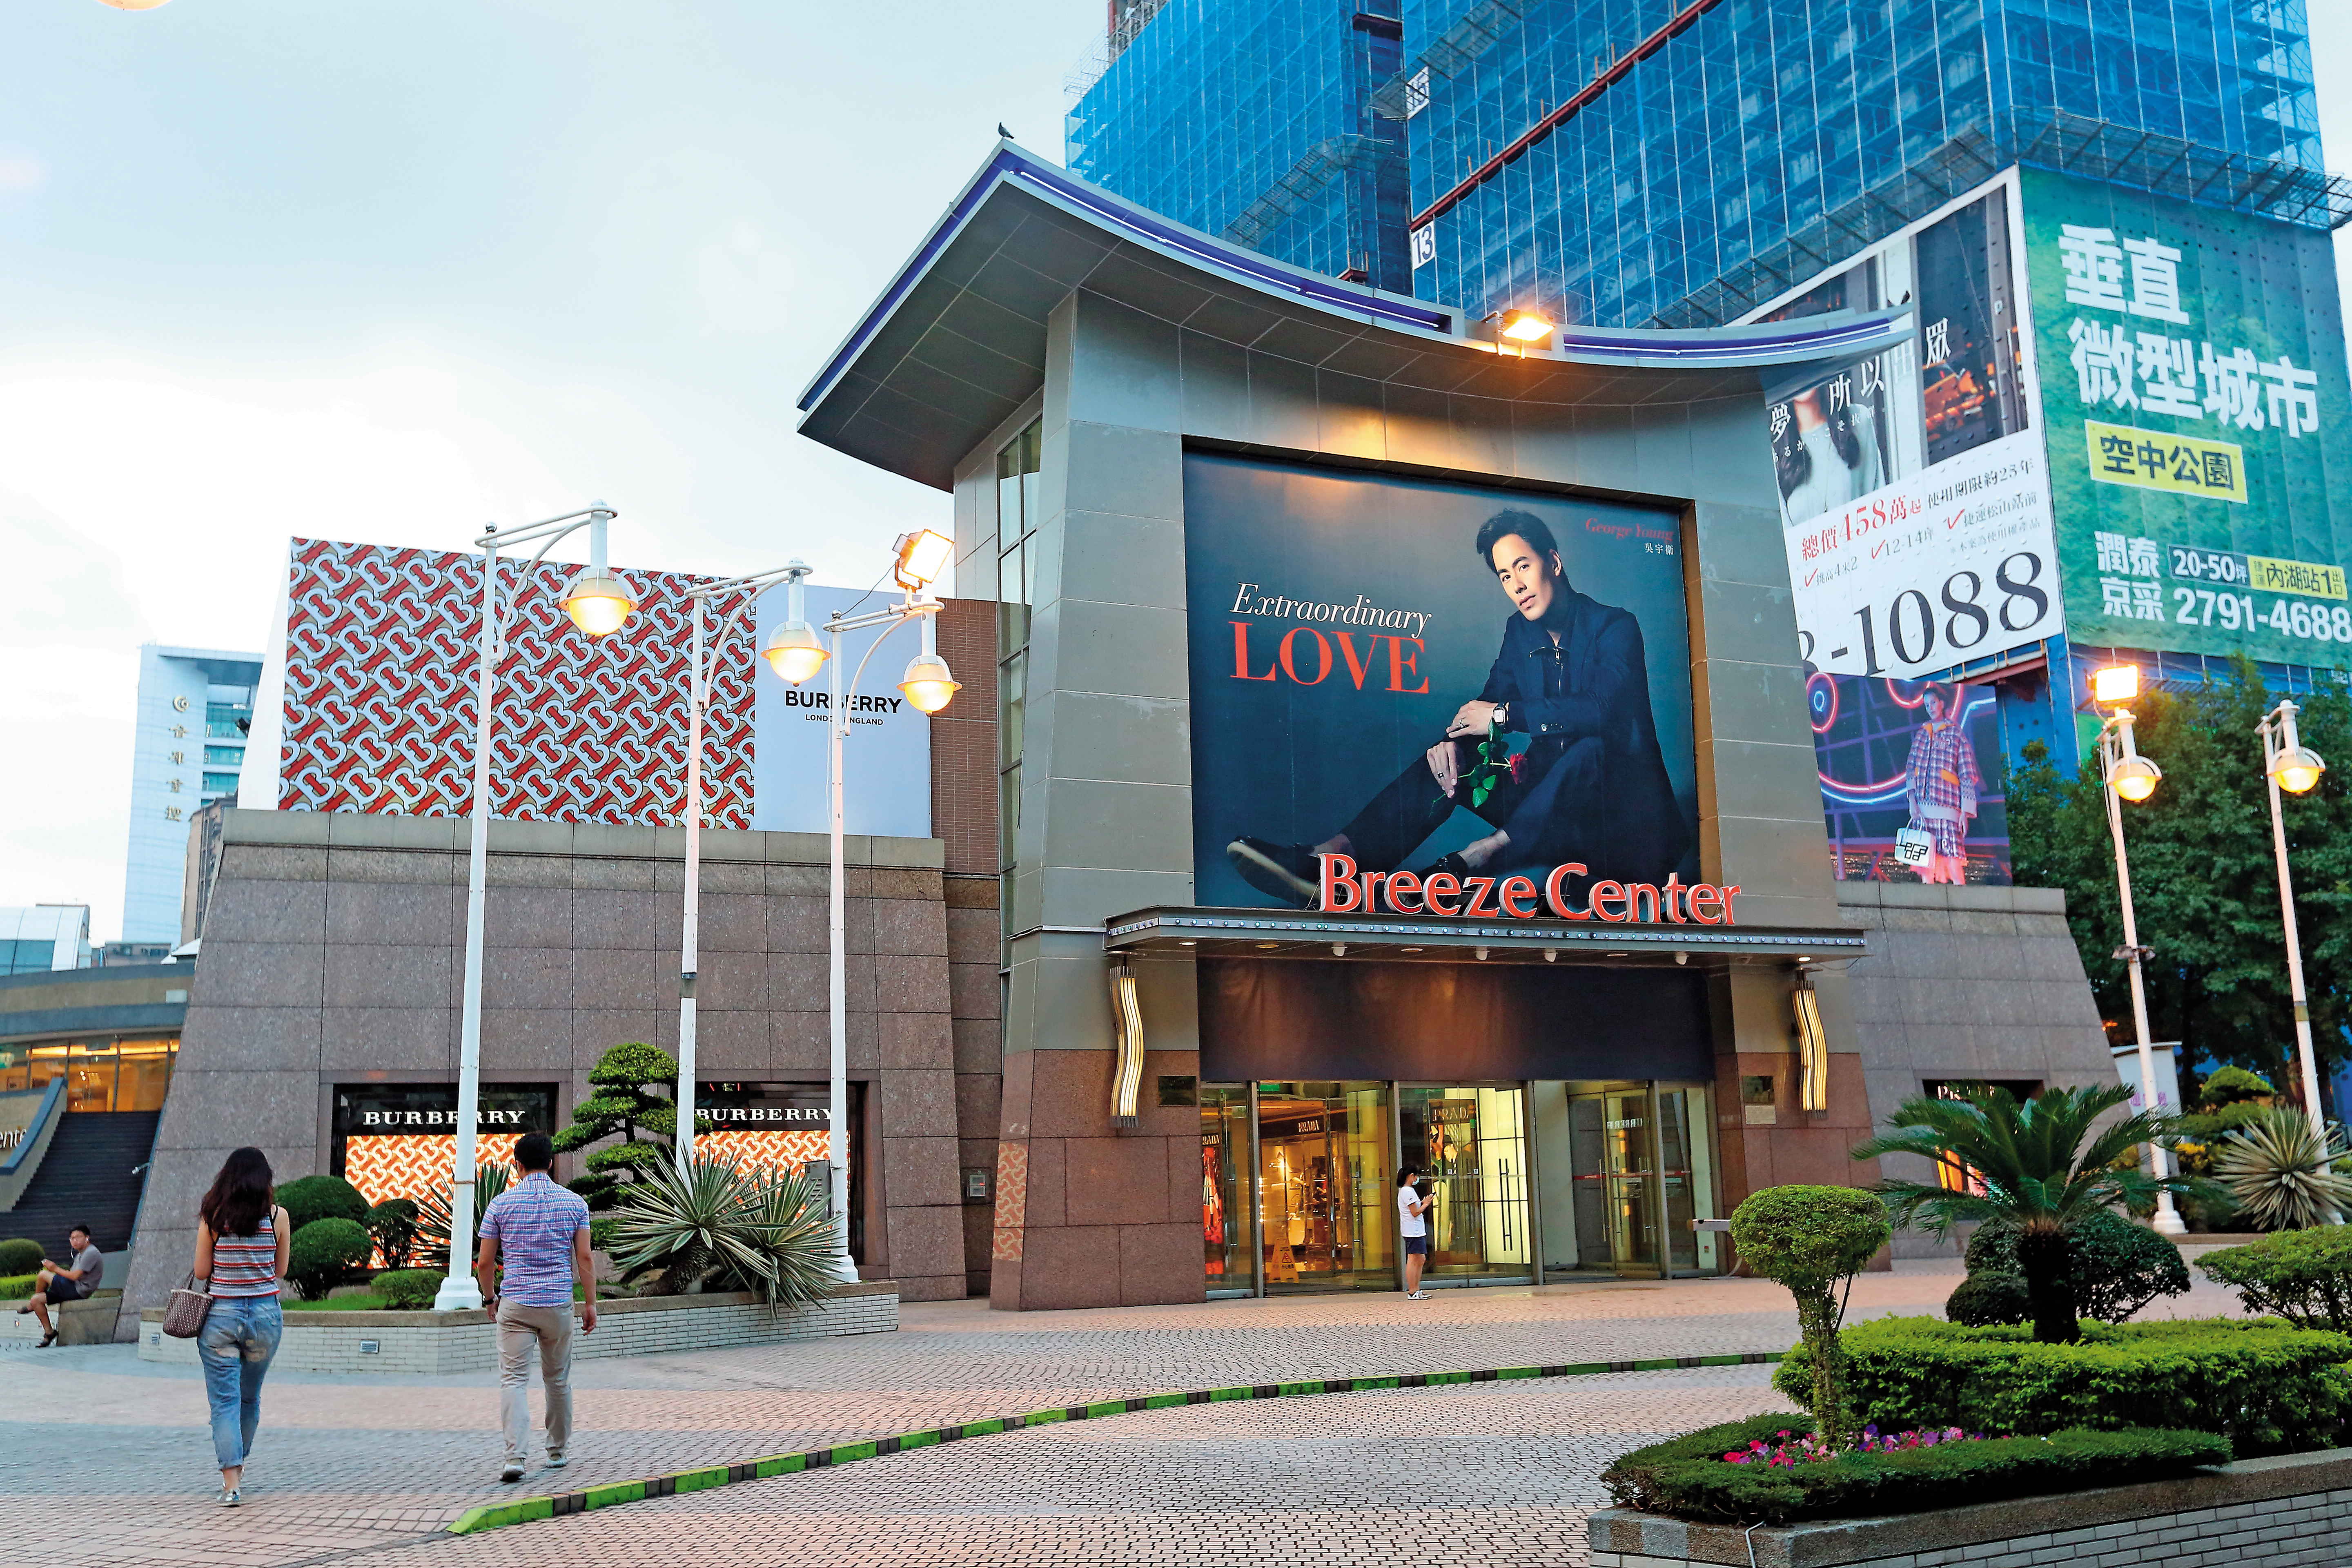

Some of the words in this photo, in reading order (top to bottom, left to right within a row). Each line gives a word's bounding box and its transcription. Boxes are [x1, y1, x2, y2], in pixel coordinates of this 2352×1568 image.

[1412, 225, 1432, 264] 13
[2058, 223, 2190, 325] 垂直
[2067, 317, 2320, 439] 微型城市
[2100, 435, 2234, 490] 空中公園
[2094, 530, 2161, 579] 潤泰
[1229, 582, 1433, 639] Extraordinary
[2173, 587, 2352, 644] 2791-4688
[1228, 621, 1429, 694] LOVE
[805, 714, 833, 722] LOND
[1317, 851, 1538, 919] Breeze
[1546, 862, 1742, 925] Center
[1202, 1134, 1220, 1145] RADA
[1298, 1120, 1320, 1133] PRADA
